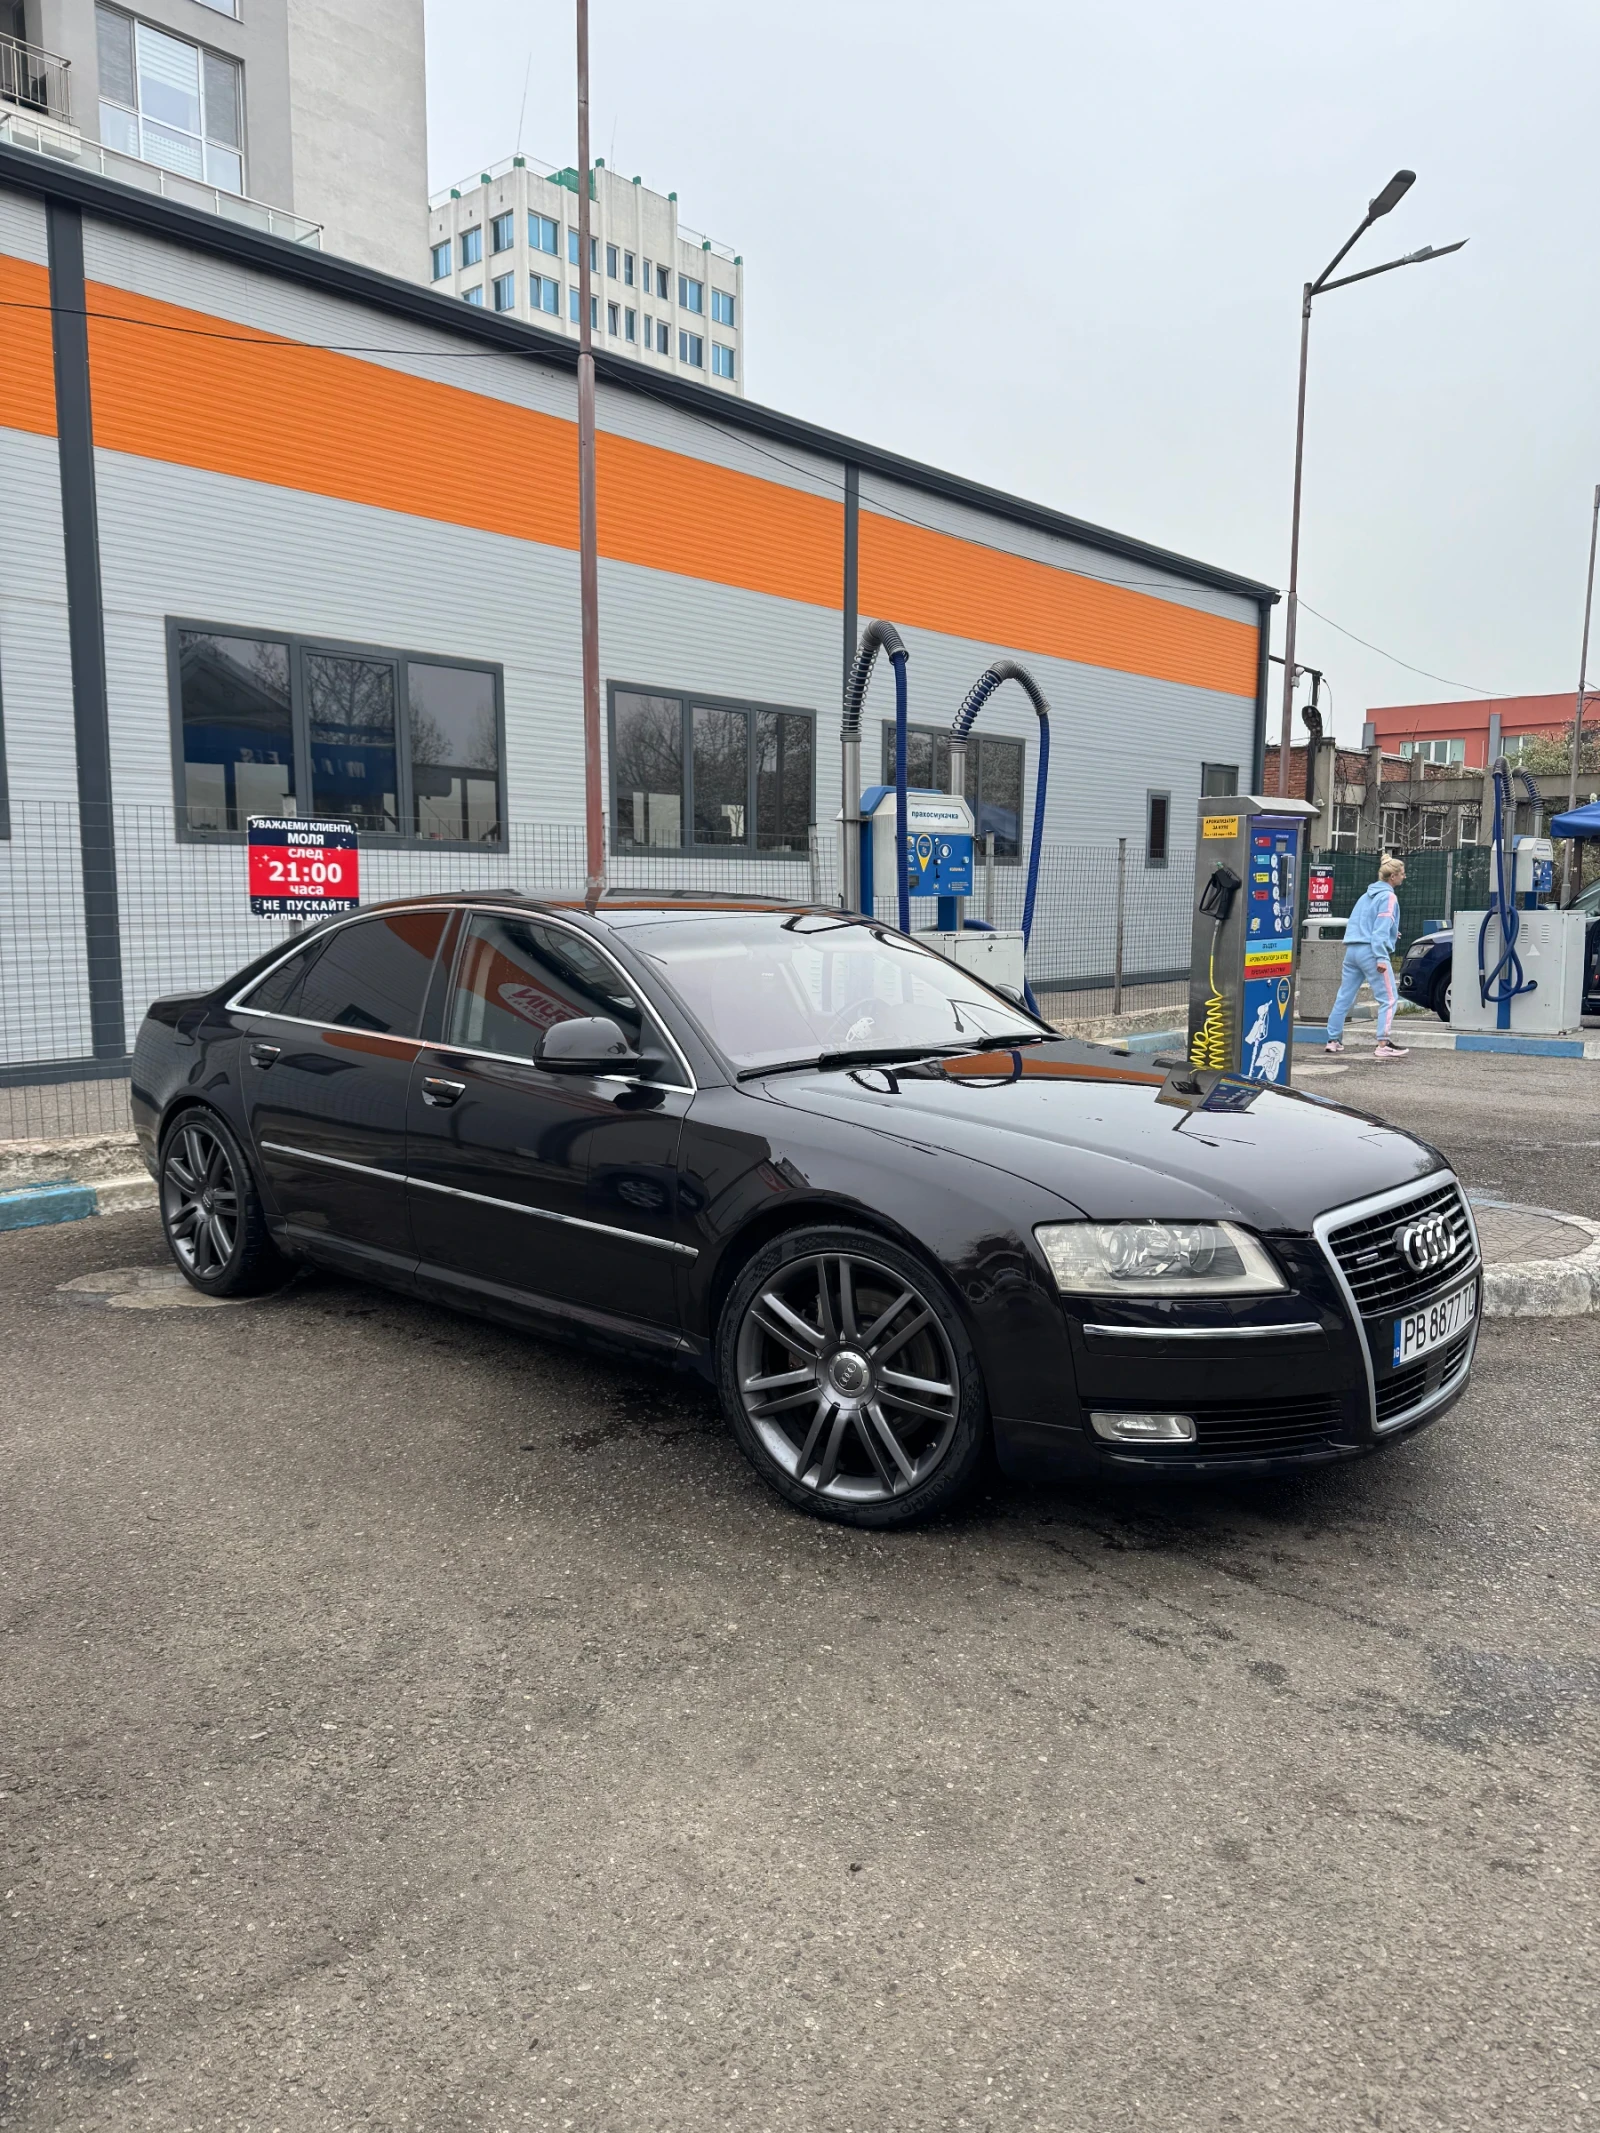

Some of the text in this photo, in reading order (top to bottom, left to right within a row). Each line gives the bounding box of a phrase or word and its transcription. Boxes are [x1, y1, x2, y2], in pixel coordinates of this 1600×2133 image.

[912, 811, 958, 820] прахосмукачка
[252, 820, 354, 835] УВАЖАЕМИ КЛИЕНТИ,
[287, 833, 325, 845] МОЛЯ
[288, 848, 324, 861] след
[268, 861, 342, 883] 21:00
[289, 885, 324, 895] часа
[1312, 884, 1329, 894] 21:00
[263, 899, 351, 911] НЕ ПУСКАЙТЕ
[1404, 1282, 1475, 1355] PB 8877 TC
